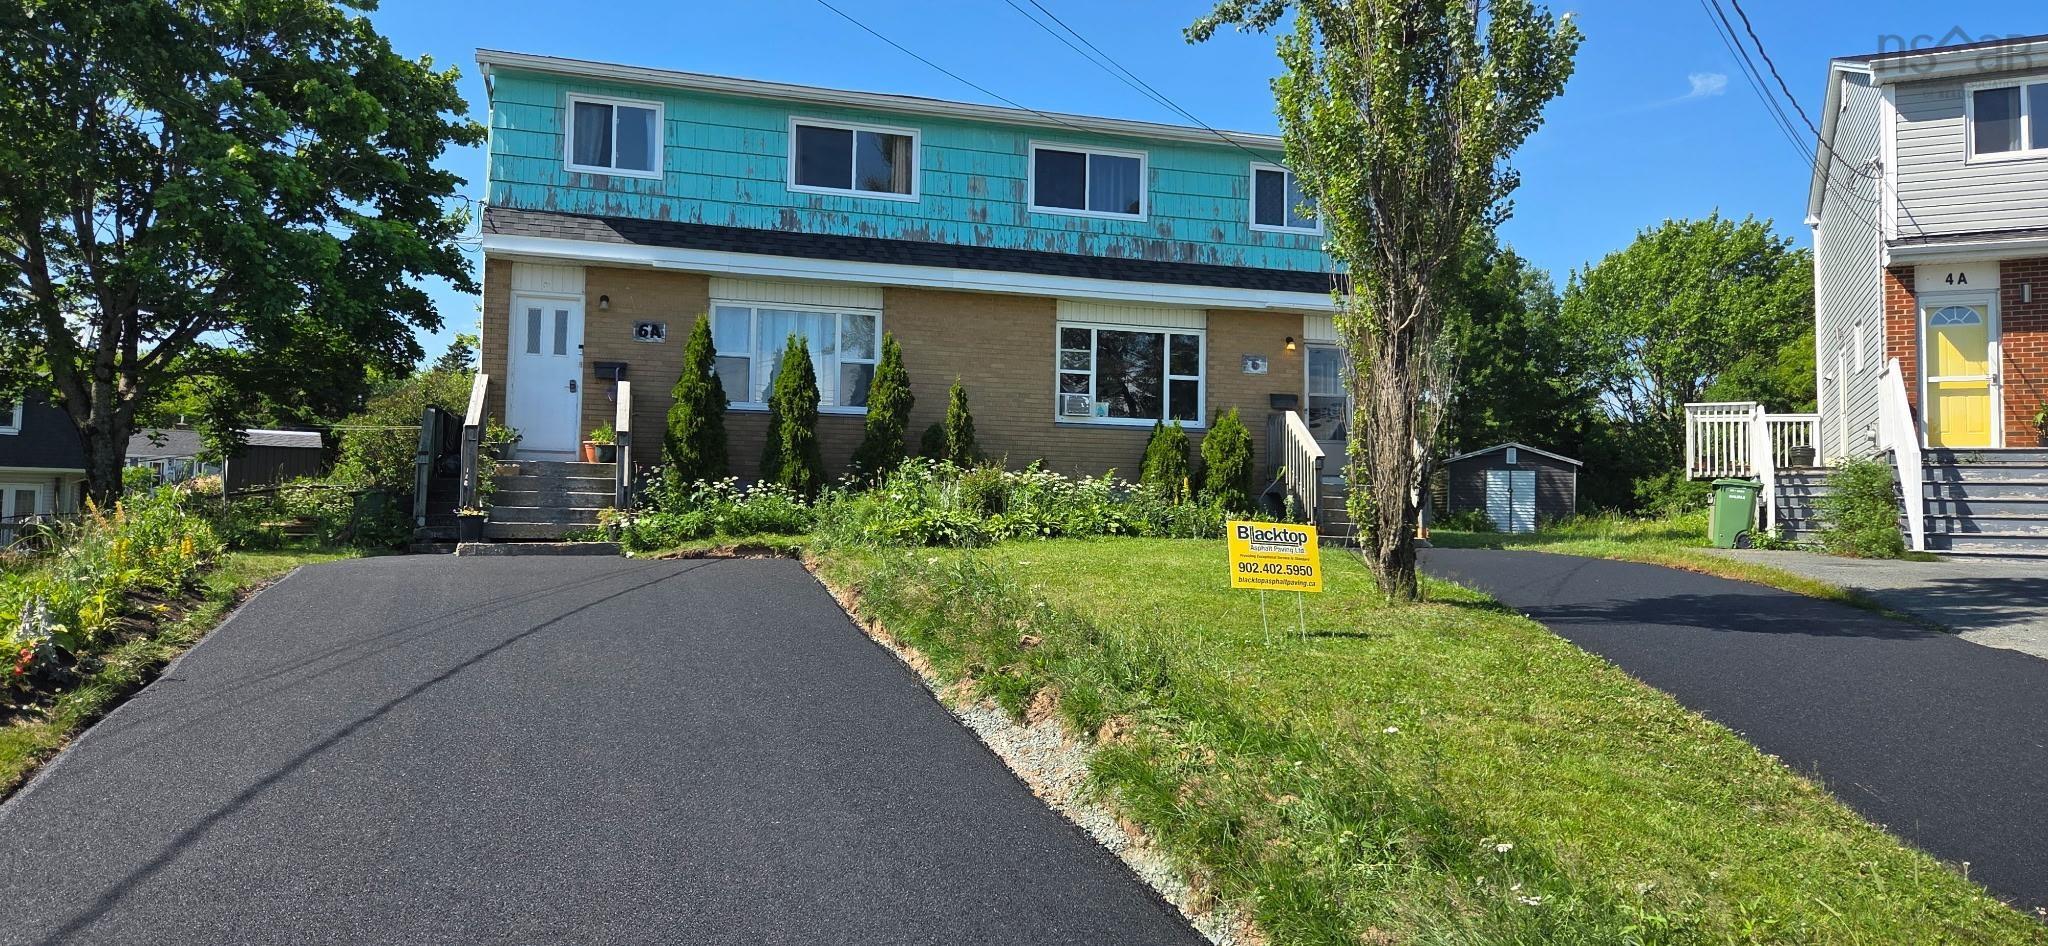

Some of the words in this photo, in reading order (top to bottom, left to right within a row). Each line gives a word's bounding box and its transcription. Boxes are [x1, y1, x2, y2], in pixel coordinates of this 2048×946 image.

[638, 324, 661, 338] 6A
[1237, 525, 1308, 546] Blacktop
[1250, 544, 1273, 552] Asphalt
[1274, 546, 1294, 554] Paving
[1238, 561, 1313, 577] 902.402.5950
[1238, 576, 1316, 588] blacktopasphaltpaving.ca
